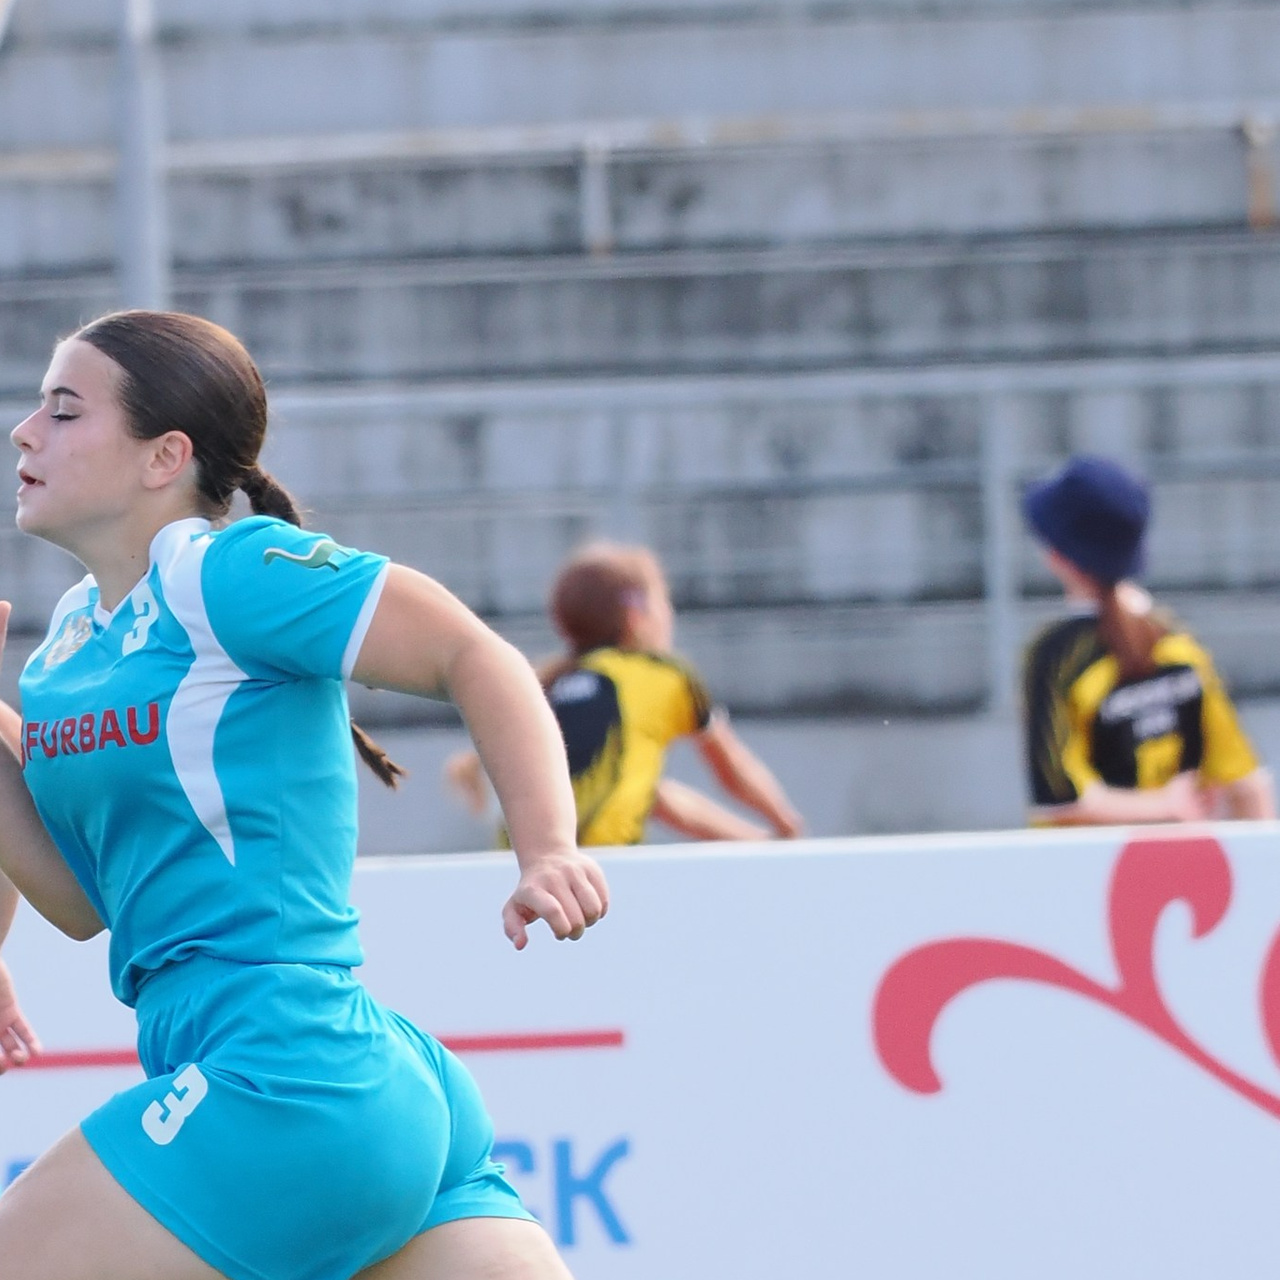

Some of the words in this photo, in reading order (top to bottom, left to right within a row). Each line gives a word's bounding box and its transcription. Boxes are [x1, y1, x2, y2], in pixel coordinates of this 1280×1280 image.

[122, 582, 159, 657] 3
[20, 703, 159, 770] FURBAU
[141, 1062, 209, 1146] 3
